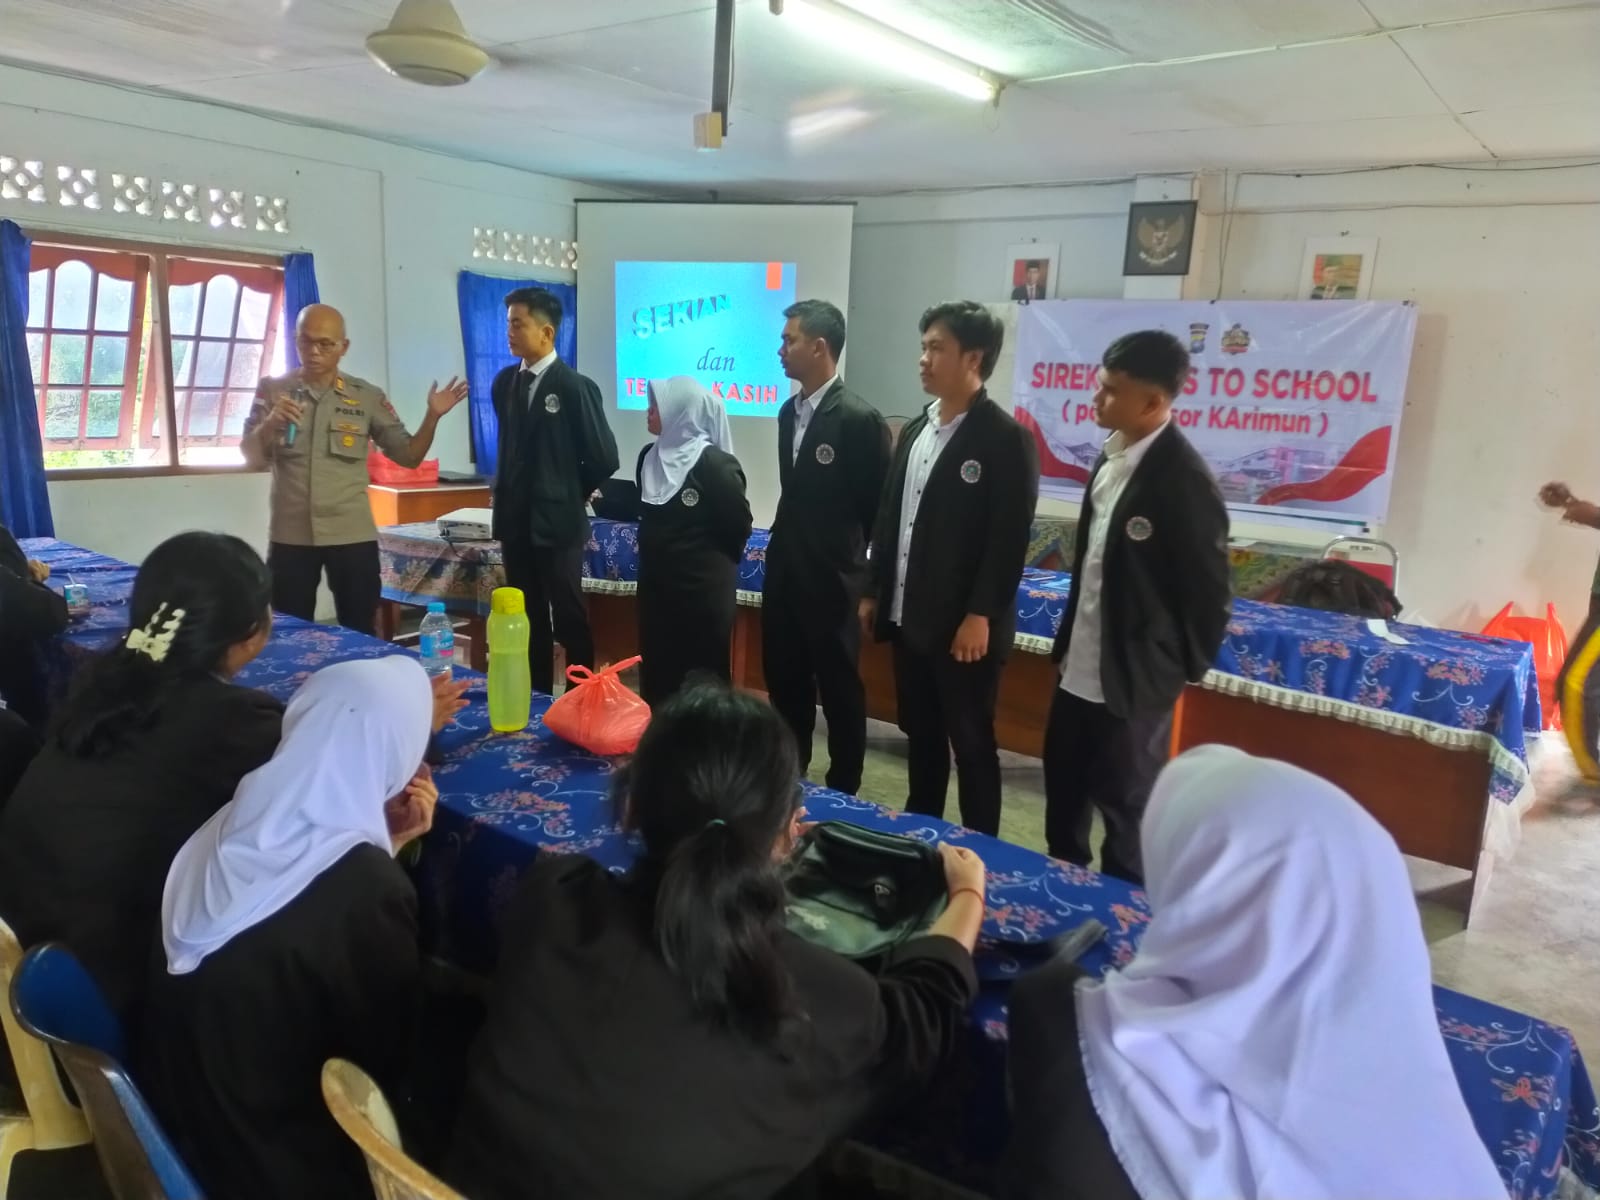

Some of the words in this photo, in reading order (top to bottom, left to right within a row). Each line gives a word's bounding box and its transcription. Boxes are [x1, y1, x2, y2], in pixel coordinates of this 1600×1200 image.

[631, 293, 732, 339] SEKIAN
[696, 347, 736, 372] dan
[711, 381, 778, 404] KASIH
[1031, 361, 1101, 391] SIREK
[1208, 367, 1246, 398] TO
[1252, 368, 1378, 403] SCHOOL
[335, 406, 365, 416] POLRI
